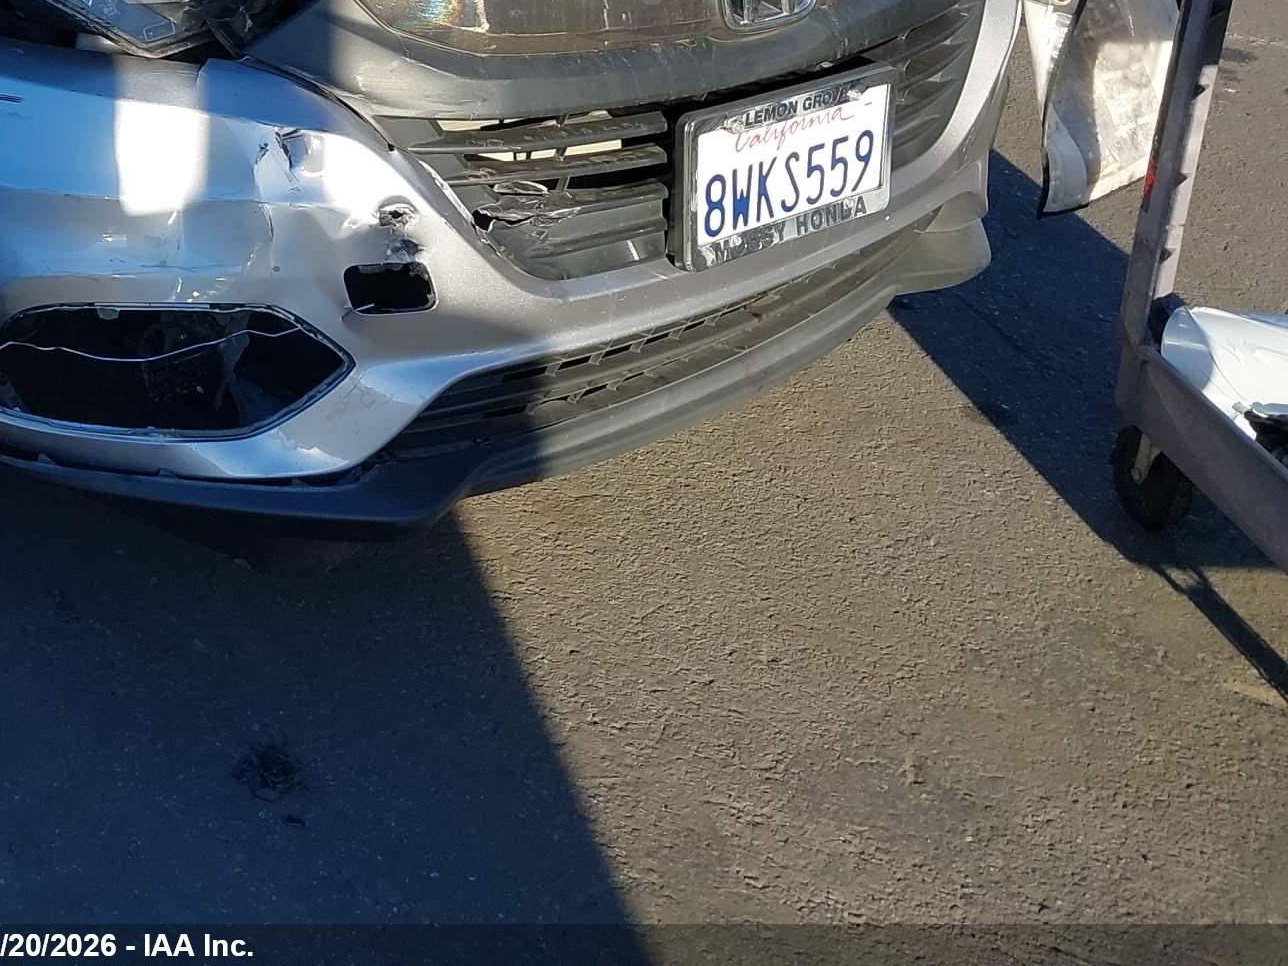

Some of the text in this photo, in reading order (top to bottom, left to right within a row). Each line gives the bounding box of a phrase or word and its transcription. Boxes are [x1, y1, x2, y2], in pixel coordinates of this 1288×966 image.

[734, 105, 854, 153] California
[744, 99, 799, 127] LEMON
[703, 129, 875, 238] 8WKS559
